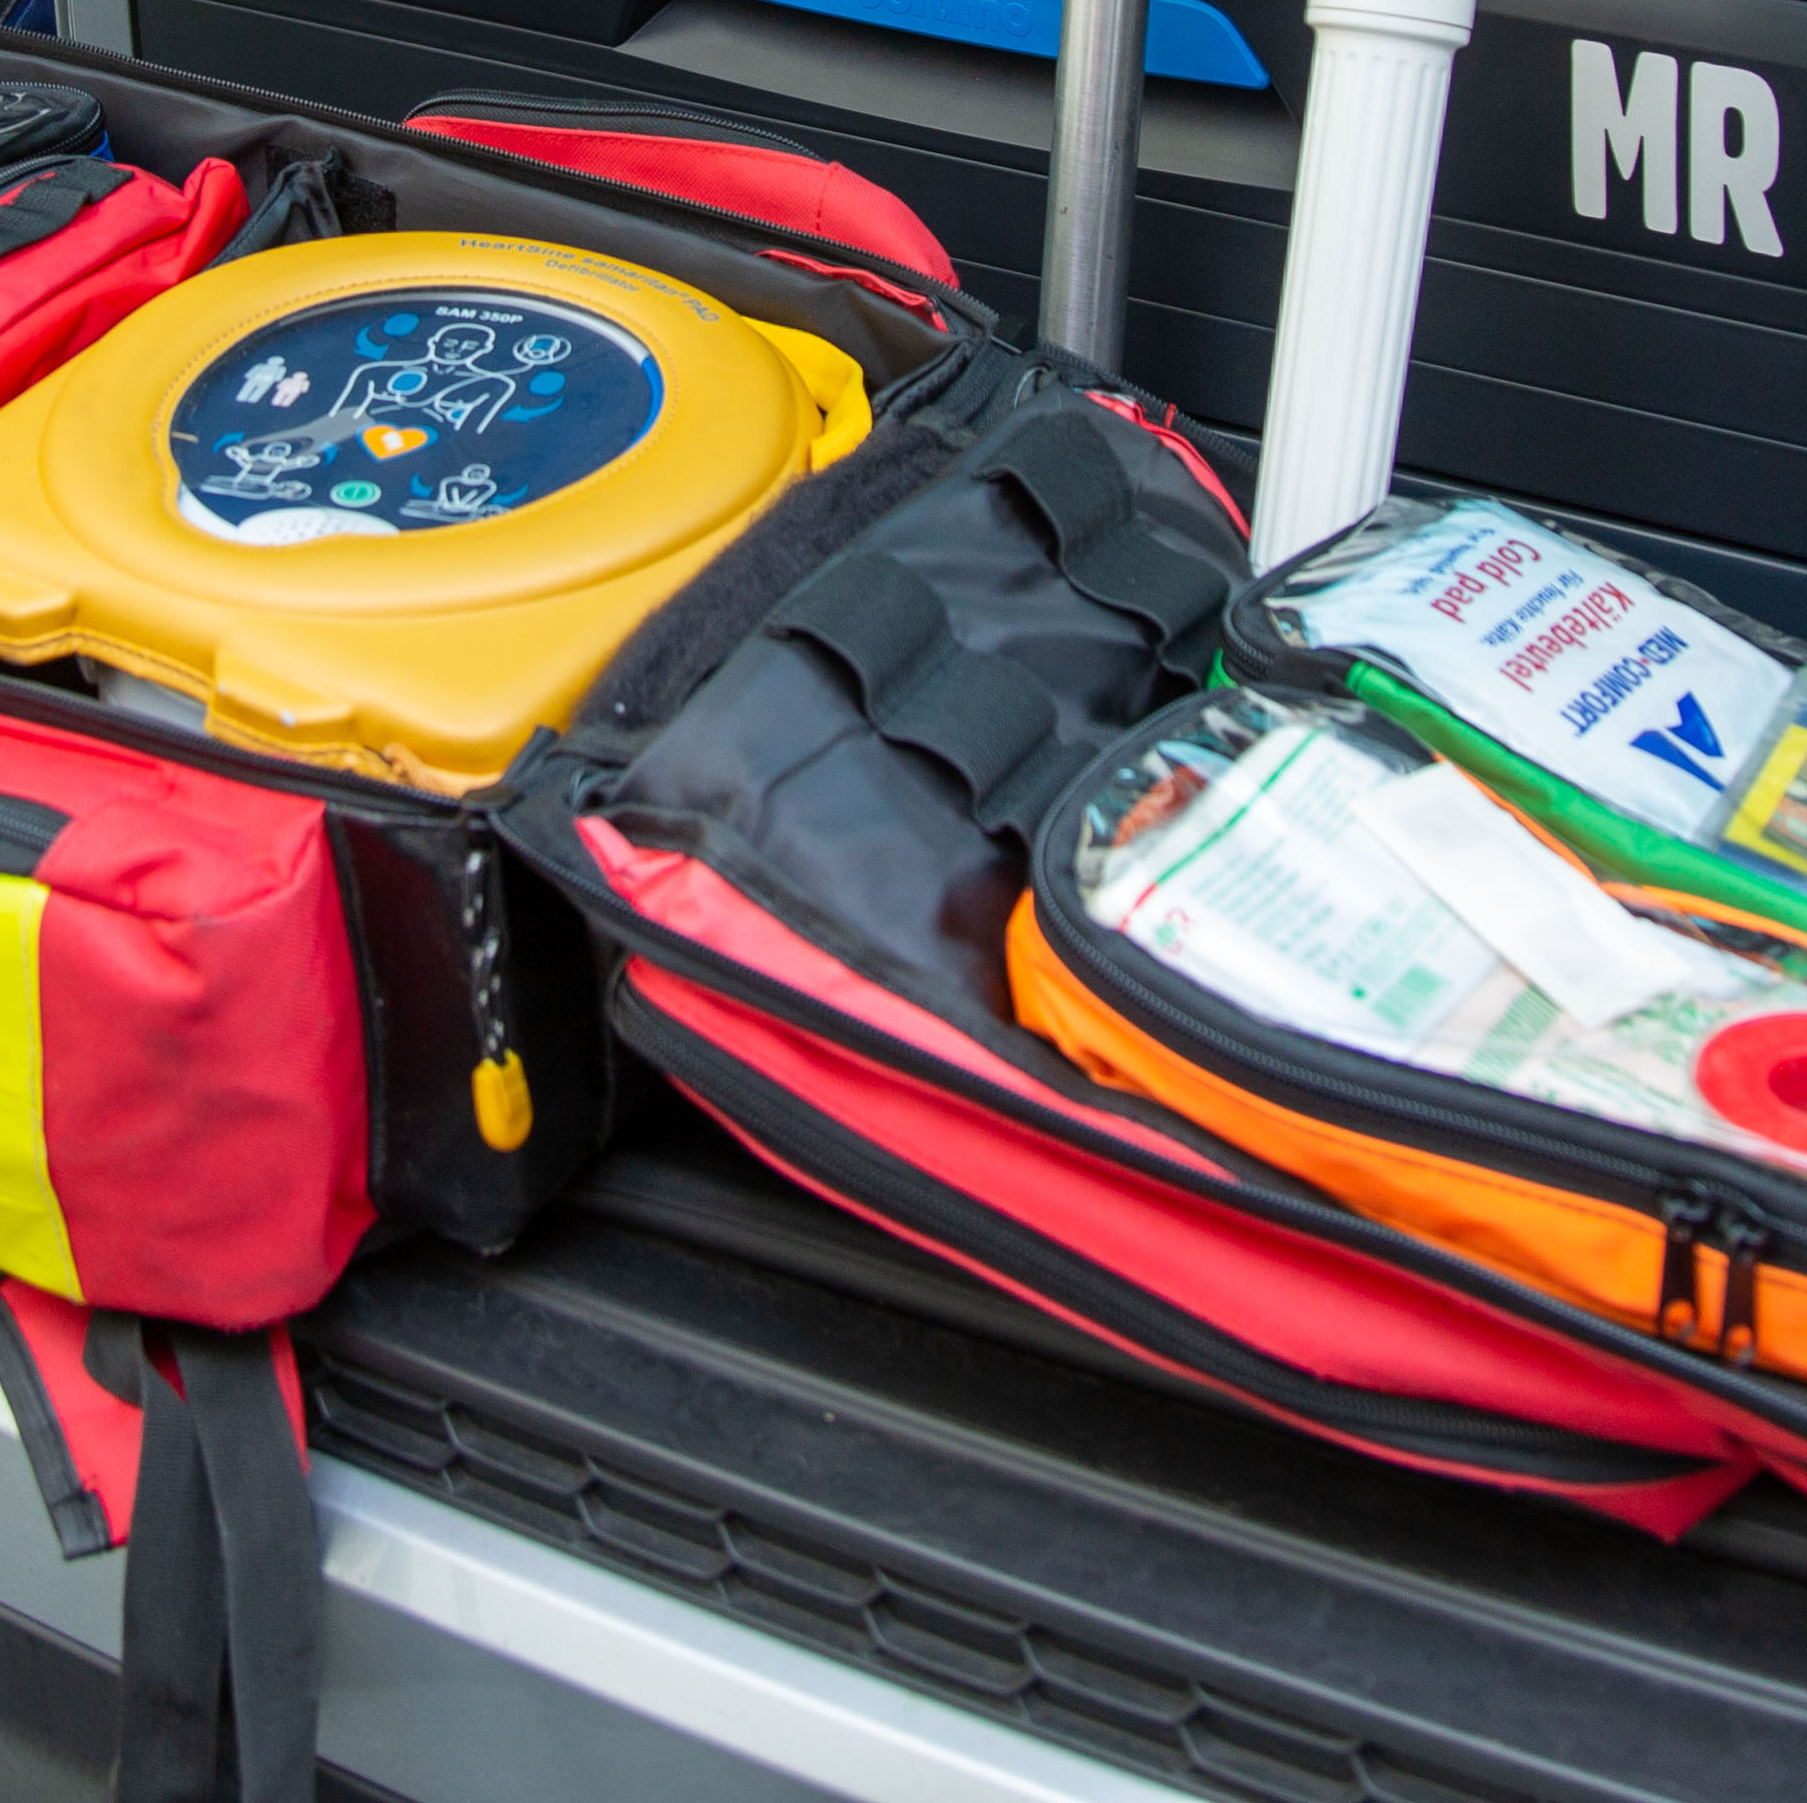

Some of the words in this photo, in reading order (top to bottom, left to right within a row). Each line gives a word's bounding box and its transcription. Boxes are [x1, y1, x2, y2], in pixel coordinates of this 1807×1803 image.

[1572, 39, 1783, 257] MR
[459, 237, 576, 260] HeartSine
[545, 258, 640, 292] Defibrillator
[435, 306, 477, 319] SAM
[479, 310, 524, 324] 350P
[1475, 538, 1542, 588] Cold
[1430, 570, 1487, 624] pad
[1498, 581, 1635, 695] Kältebeutel
